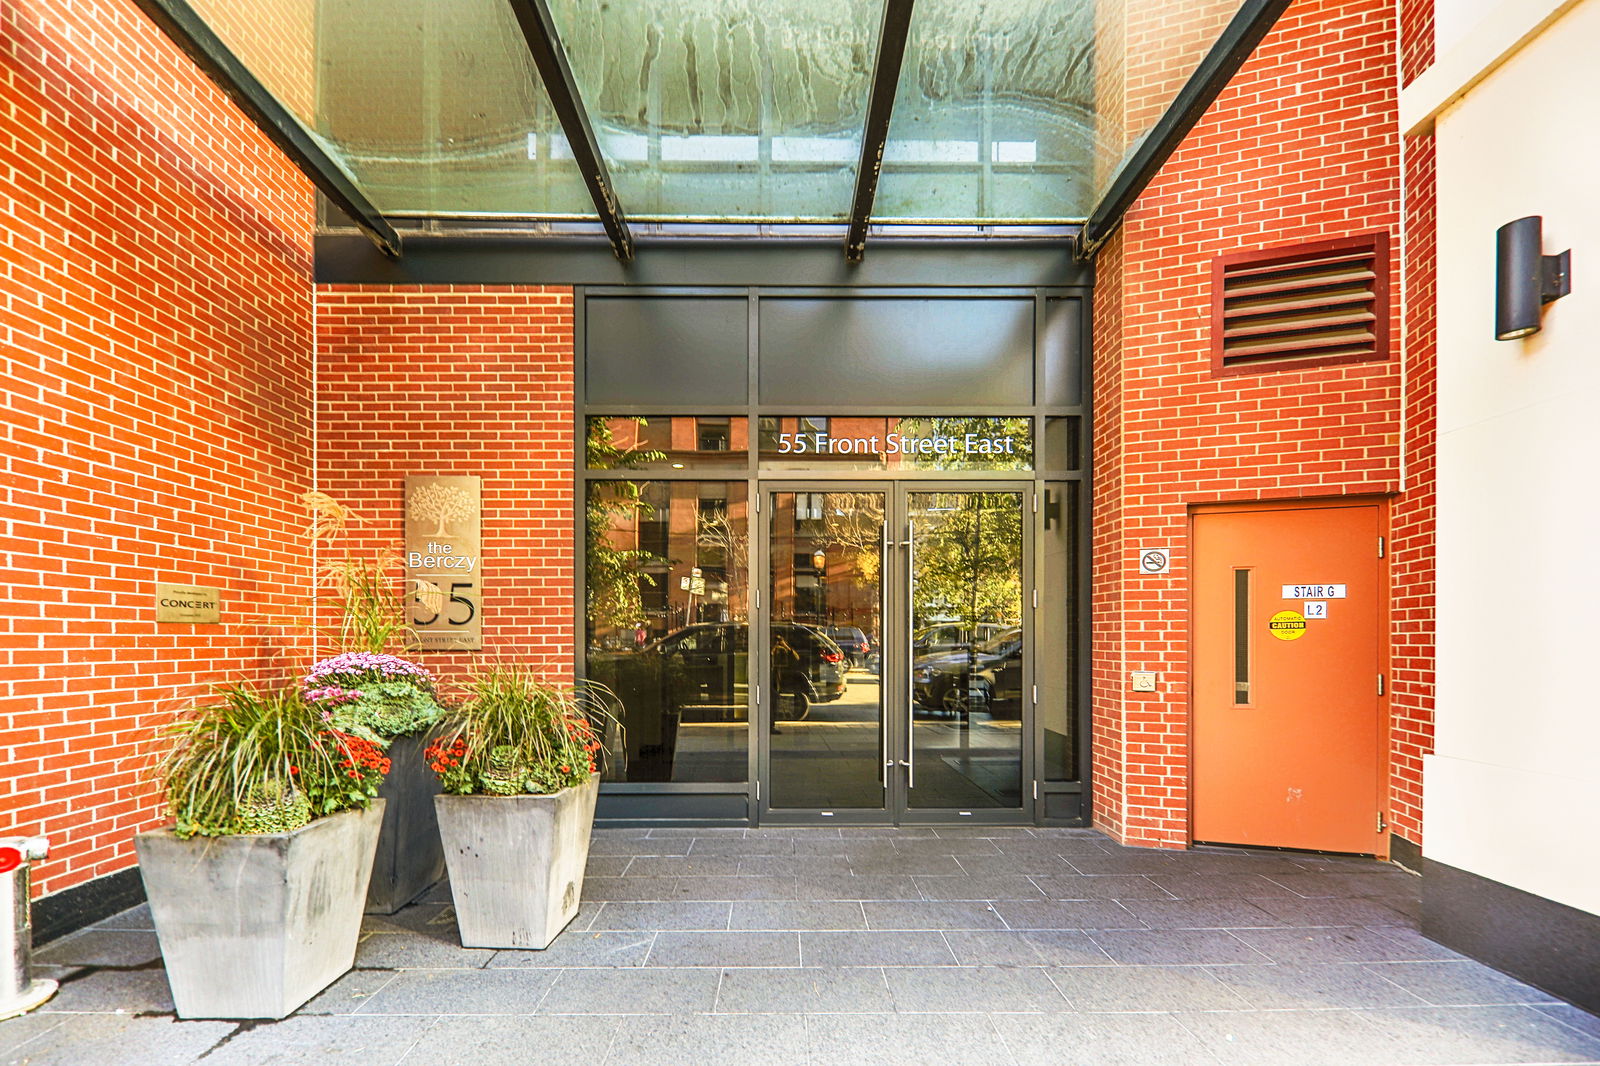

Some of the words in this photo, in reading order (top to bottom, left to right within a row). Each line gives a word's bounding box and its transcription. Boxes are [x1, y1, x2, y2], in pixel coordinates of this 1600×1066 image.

[778, 433, 807, 453] 55
[815, 433, 879, 453] Front
[886, 433, 957, 453] Street
[965, 433, 1014, 453] East
[428, 542, 452, 554] the
[408, 552, 477, 572] Berczy
[1294, 586, 1324, 597] STAIR
[1327, 586, 1335, 597] G
[160, 598, 215, 609] CONCERT
[1307, 604, 1323, 616] L2
